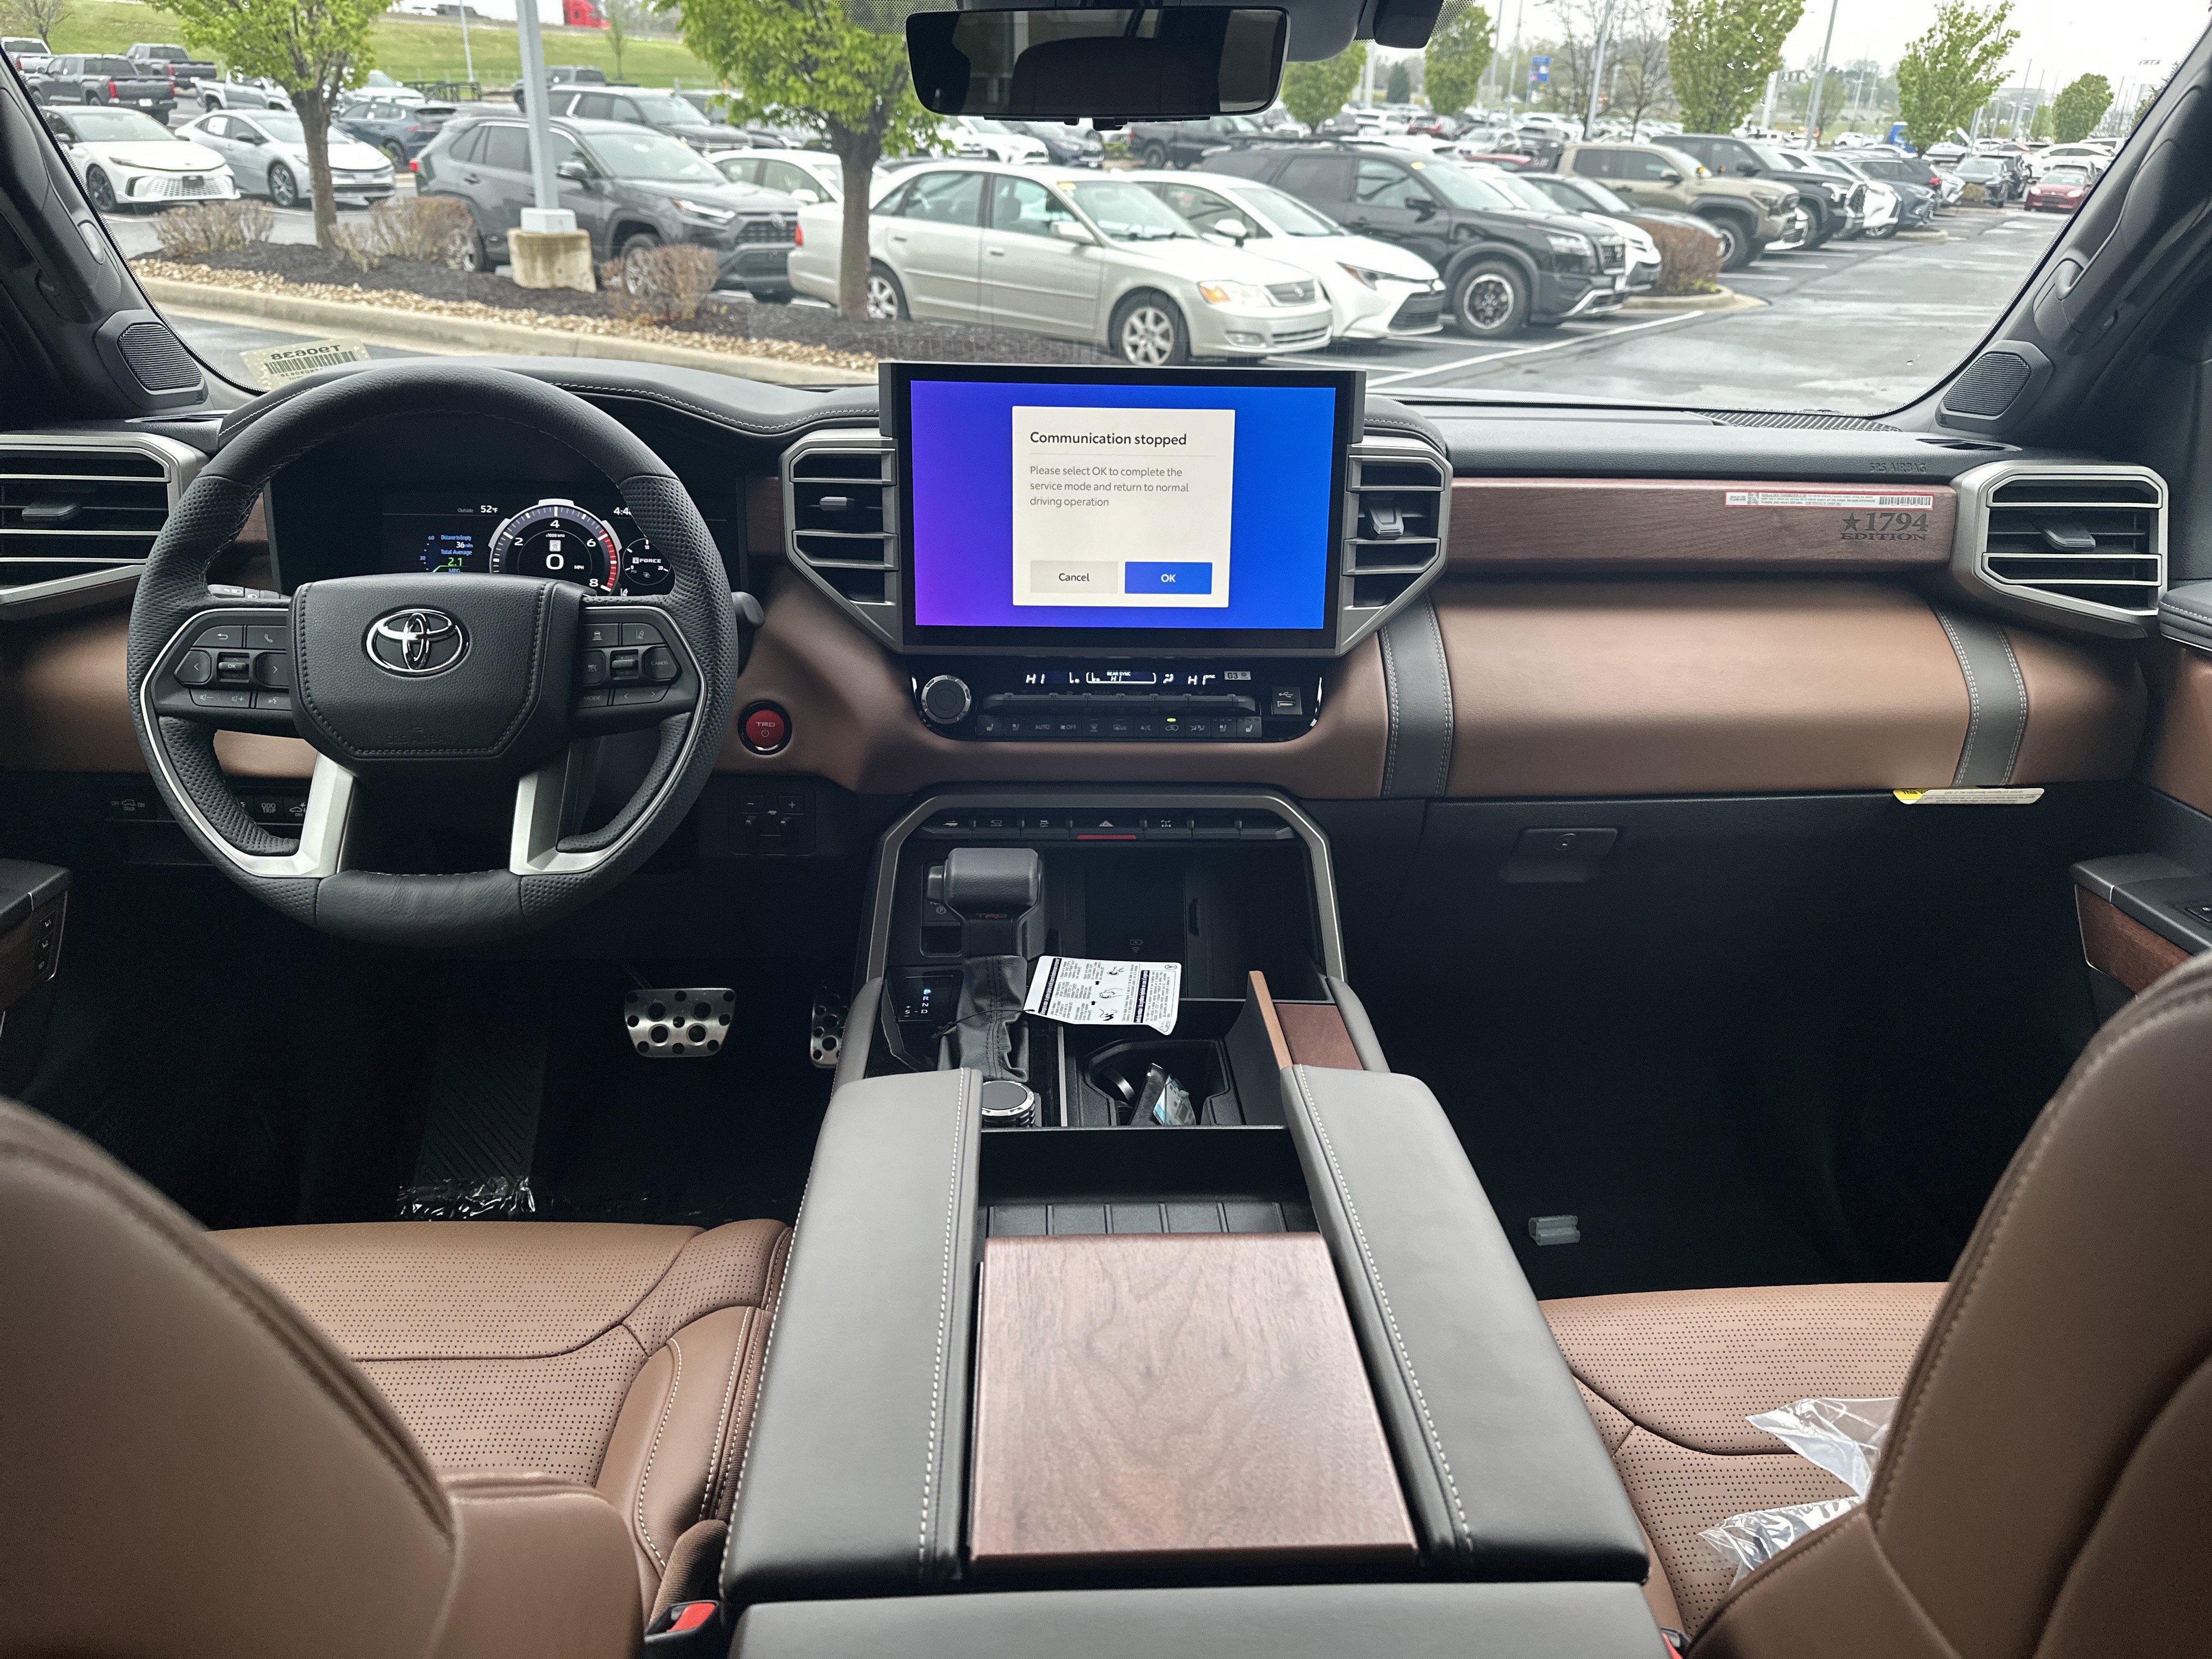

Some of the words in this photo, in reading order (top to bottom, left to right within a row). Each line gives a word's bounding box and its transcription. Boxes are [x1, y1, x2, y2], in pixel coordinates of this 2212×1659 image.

[1030, 431, 1131, 444] Communication
[1134, 433, 1187, 447] stopped
[1030, 466, 1060, 475] Please
[1062, 466, 1090, 475] select
[1092, 467, 1107, 476] OK
[1109, 467, 1119, 476] to
[1120, 467, 1165, 478] complete
[1167, 468, 1182, 476] the
[1891, 462, 1927, 473] AIRBAG
[1030, 481, 1062, 490] service
[1064, 482, 1091, 491] mode
[1093, 482, 1111, 491] and
[1114, 483, 1142, 492] return
[1144, 483, 1153, 492] to
[1155, 483, 1189, 492] normal
[1030, 496, 1062, 507] driving
[1064, 497, 1109, 507] operation
[550, 520, 560, 528] 4
[1866, 512, 1928, 532] 1794
[514, 537, 523, 546] 2
[586, 538, 596, 547] 6
[447, 557, 462, 566] 2.1
[546, 554, 565, 570] 0
[589, 578, 599, 587] 8
[1058, 573, 1090, 582] Cancel
[1161, 574, 1176, 583] OK
